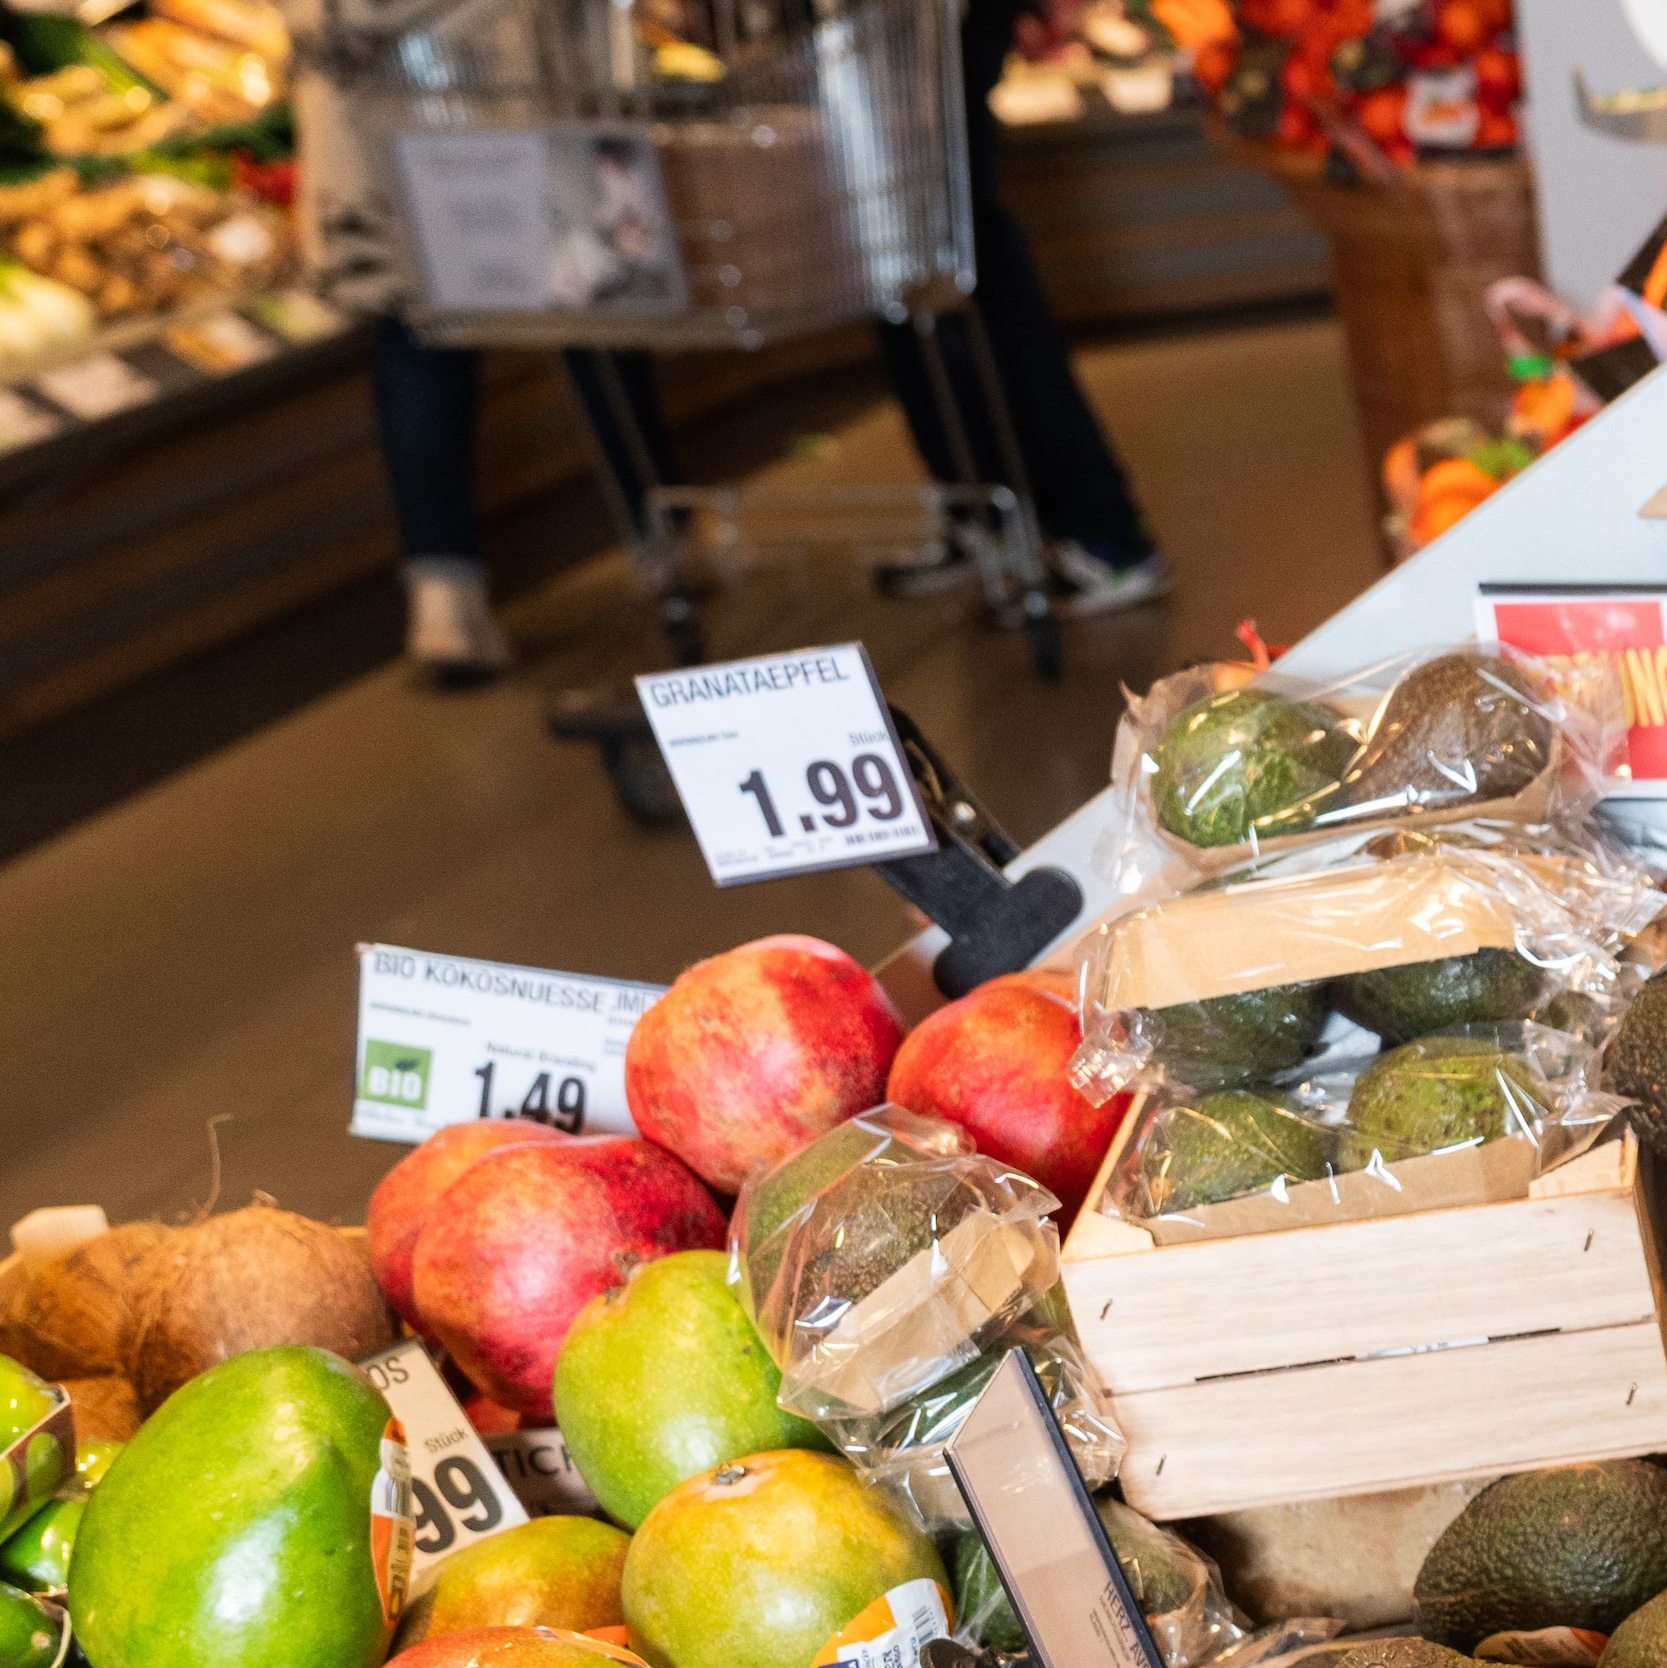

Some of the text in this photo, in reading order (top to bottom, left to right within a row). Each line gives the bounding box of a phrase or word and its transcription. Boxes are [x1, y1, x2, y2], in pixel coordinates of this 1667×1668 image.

[651, 657, 851, 708] GRANATAEPFEL
[848, 729, 891, 746] Stück
[739, 753, 905, 838] 1.99
[375, 951, 416, 980] BIO
[423, 963, 602, 1014] KOKOSNUESSE
[368, 1067, 423, 1100] BIO
[474, 1060, 587, 1135] 1.49
[424, 1427, 468, 1454] Stück
